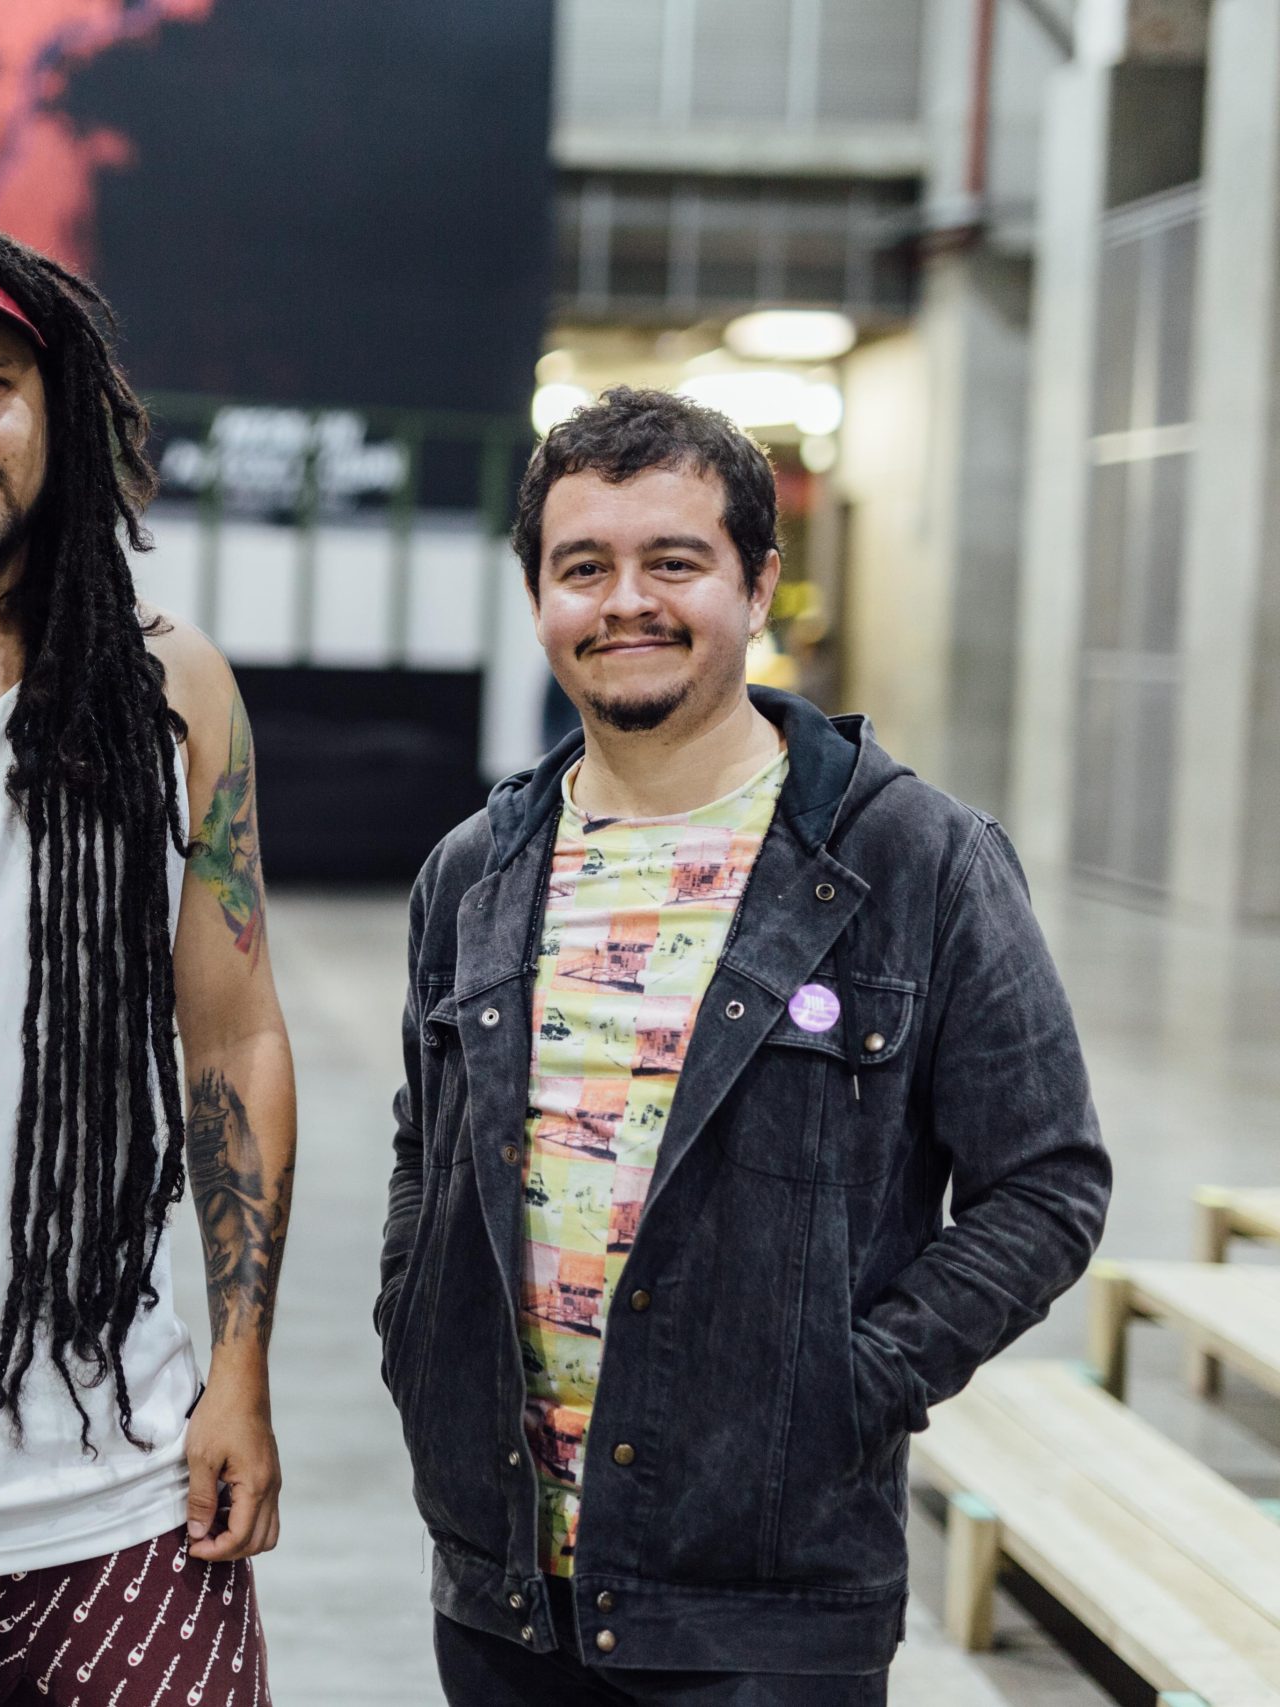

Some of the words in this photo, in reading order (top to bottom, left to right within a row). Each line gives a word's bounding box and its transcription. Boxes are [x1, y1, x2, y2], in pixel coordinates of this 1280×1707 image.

[128, 1585, 175, 1667] Champion
[180, 1560, 212, 1640] Champio
[231, 1585, 250, 1673] Champion
[76, 1614, 124, 1683] Champion
[187, 1619, 226, 1707] Champion
